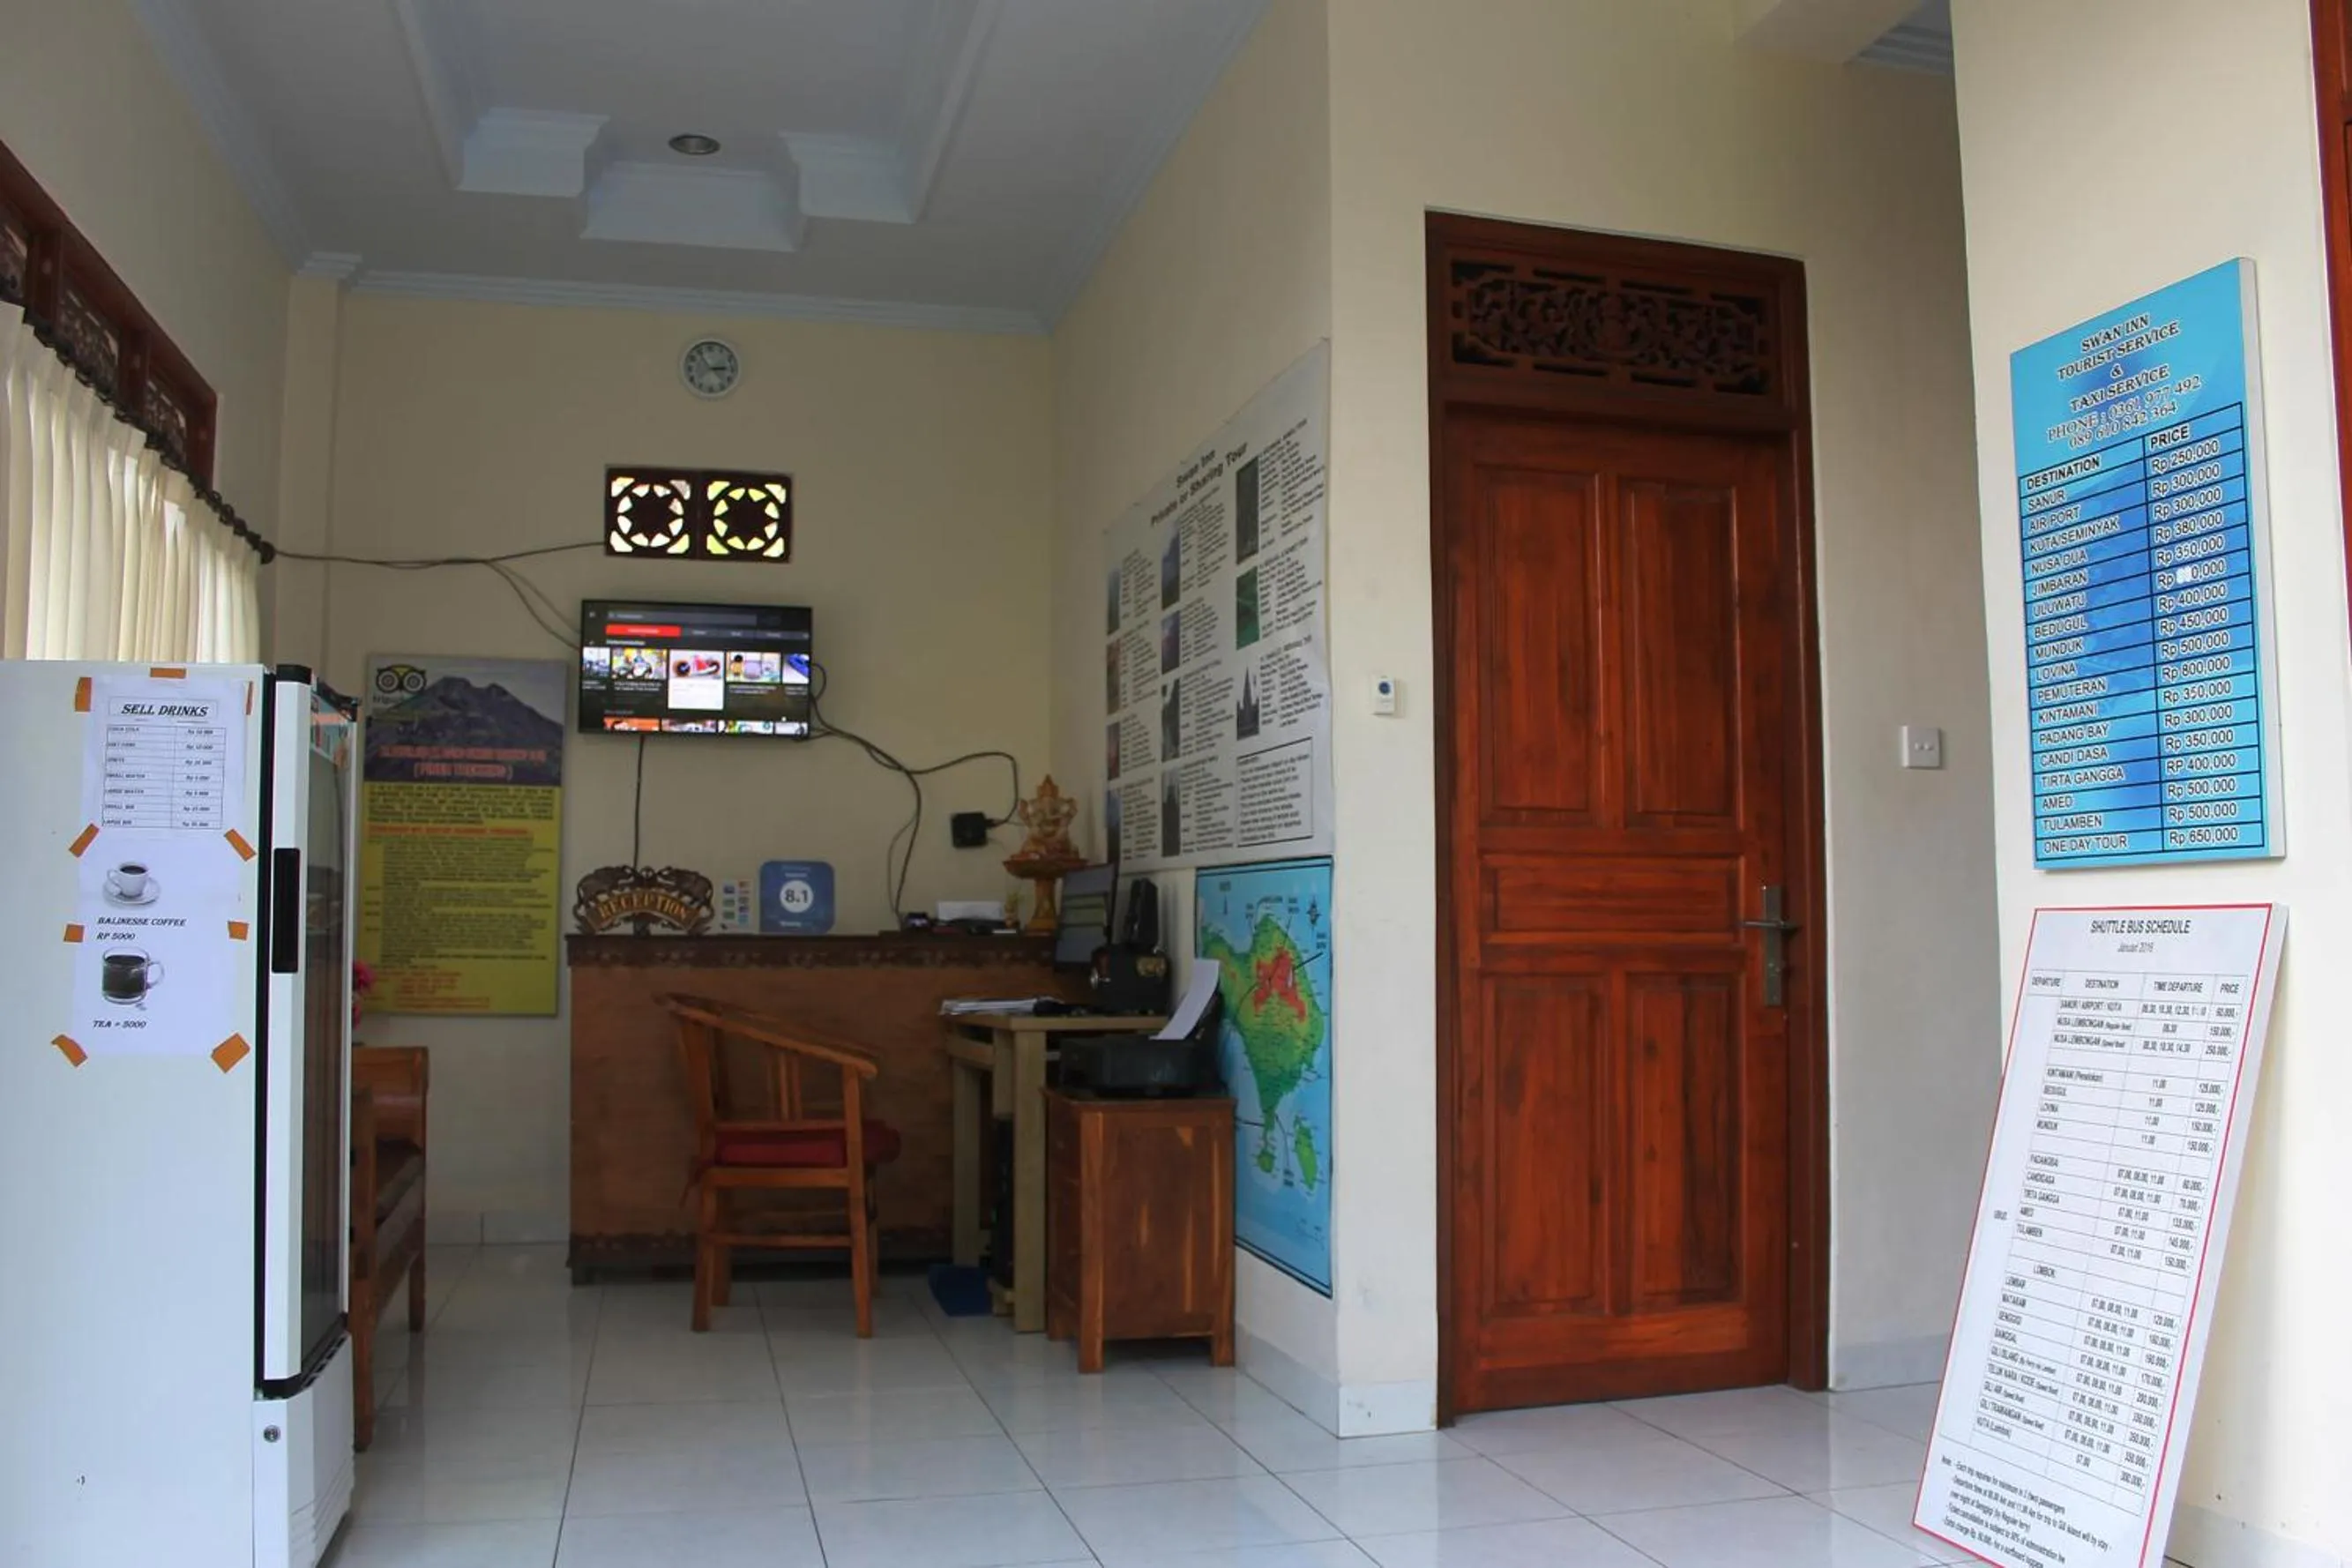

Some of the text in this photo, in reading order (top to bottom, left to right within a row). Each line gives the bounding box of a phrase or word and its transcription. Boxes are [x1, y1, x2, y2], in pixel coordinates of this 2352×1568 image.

[2058, 320, 2178, 380] TOURIST SERVICE
[2081, 313, 2148, 352] SWAN INN
[2072, 363, 2169, 412] TAXI SERVICE
[2110, 362, 2122, 378] &
[2048, 412, 2096, 441] PHONE
[2175, 374, 2199, 395] 492
[2151, 399, 2177, 419] 364
[1225, 442, 1247, 467] Tour
[2150, 425, 2188, 449] PRICE
[2027, 456, 2099, 489] DESTINATION
[2028, 439, 2218, 511] SANUR Rp 250,000
[2030, 463, 2220, 531] AIR PORT Rp 300,000
[2154, 502, 2169, 519] Rp
[2172, 487, 2221, 513] 300,000
[2031, 511, 2222, 574] NUSA DUA Rp 380,000
[2032, 535, 2223, 595] JIMBARAN Rp 350,000
[2034, 559, 2225, 616] ULUWATU Rp 0,000
[2035, 583, 2226, 638] BEDUGUL Rp 400,000
[2036, 608, 2228, 659] MUNDUK Rp 450,000
[2036, 631, 2229, 681] LOVINA Rp 500,000
[2038, 655, 2230, 701] PEMUTERAN Rp 800,000
[122, 704, 208, 717] SELL DRINKS
[2038, 681, 2231, 723] KINTAMANI Rp 350,000
[2039, 705, 2233, 744] PADANG BAY Rp 300,000
[2041, 728, 2234, 765] CANDI DASA Rp 350,000
[2041, 753, 2235, 788] TIRTA GANGGA RP 400,000
[2042, 778, 2236, 809] AMED Rp 500,000
[2042, 802, 2238, 831] TULAMBEN Rp 500,000
[2043, 826, 2239, 853] ONE DAY TOUR Rp 650,000
[598, 892, 687, 918] RECEPTION
[785, 889, 808, 903] 8.1
[2089, 920, 2191, 933] SHUTTLE BUS SCHEDULE
[2220, 983, 2239, 993] PRICE
